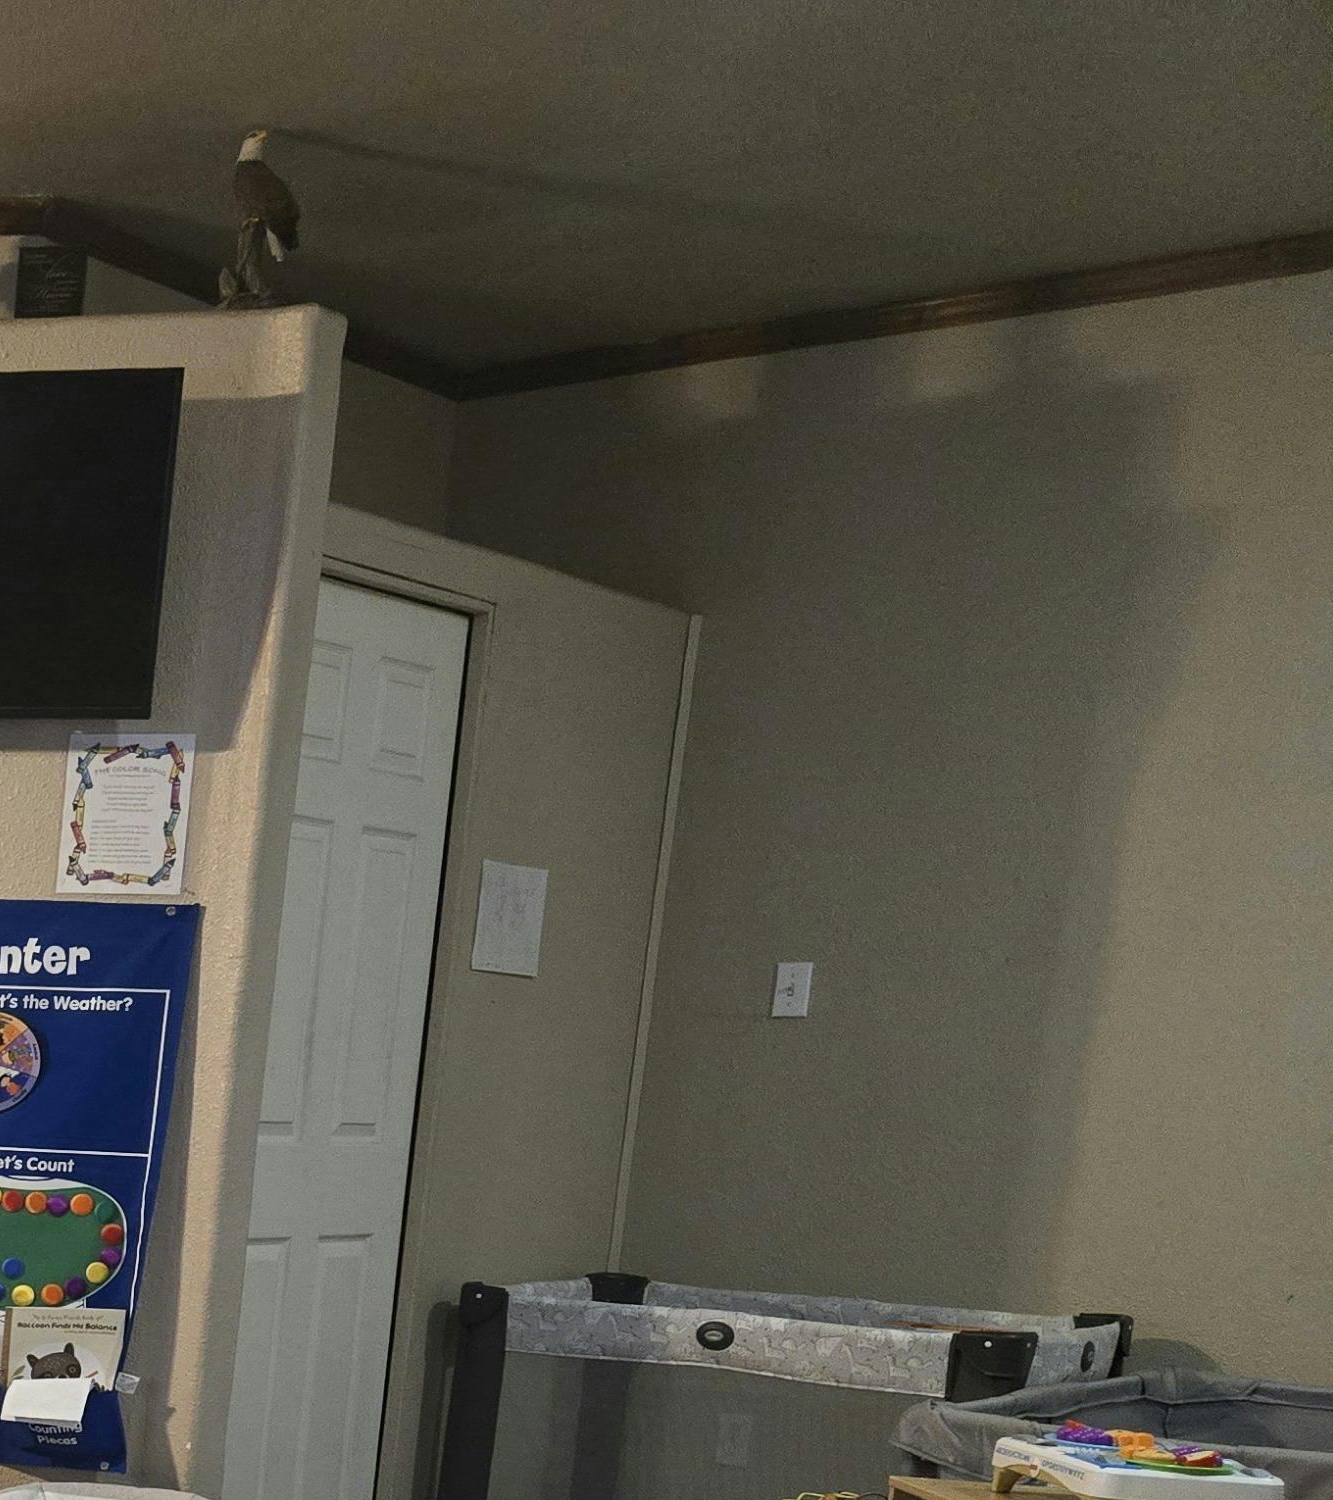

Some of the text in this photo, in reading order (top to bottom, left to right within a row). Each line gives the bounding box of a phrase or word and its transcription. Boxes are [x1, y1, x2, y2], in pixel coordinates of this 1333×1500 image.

[22, 994, 50, 1010] the
[53, 995, 134, 1012] Weather?
[27, 1156, 75, 1172] Count
[17, 1321, 51, 1329] Raccoon
[85, 1322, 118, 1331] Balance
[36, 1435, 78, 1446] Pieces
